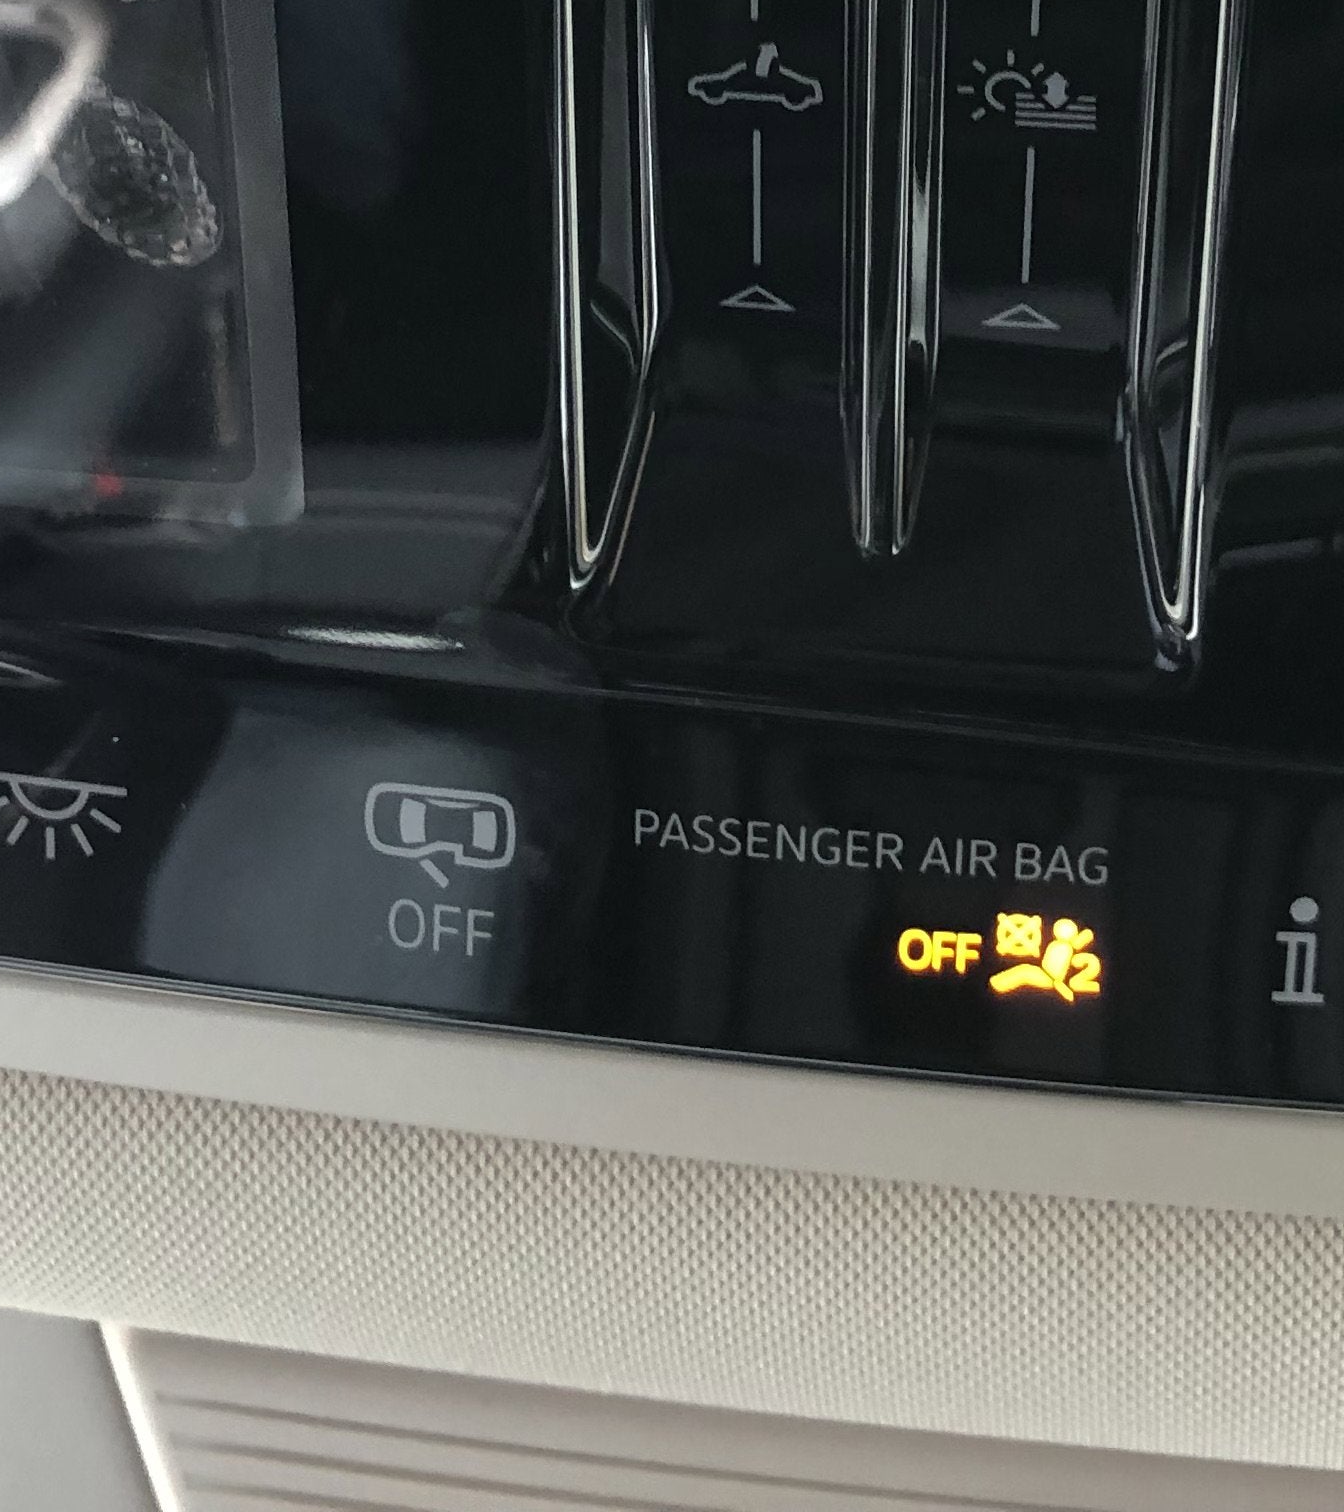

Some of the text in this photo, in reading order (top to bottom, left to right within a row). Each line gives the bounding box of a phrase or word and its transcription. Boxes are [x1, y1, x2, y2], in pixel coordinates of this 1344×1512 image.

[632, 807, 1110, 887] PASSENGER AIR BAG
[388, 897, 496, 958] OFF
[897, 927, 984, 976] OFF
